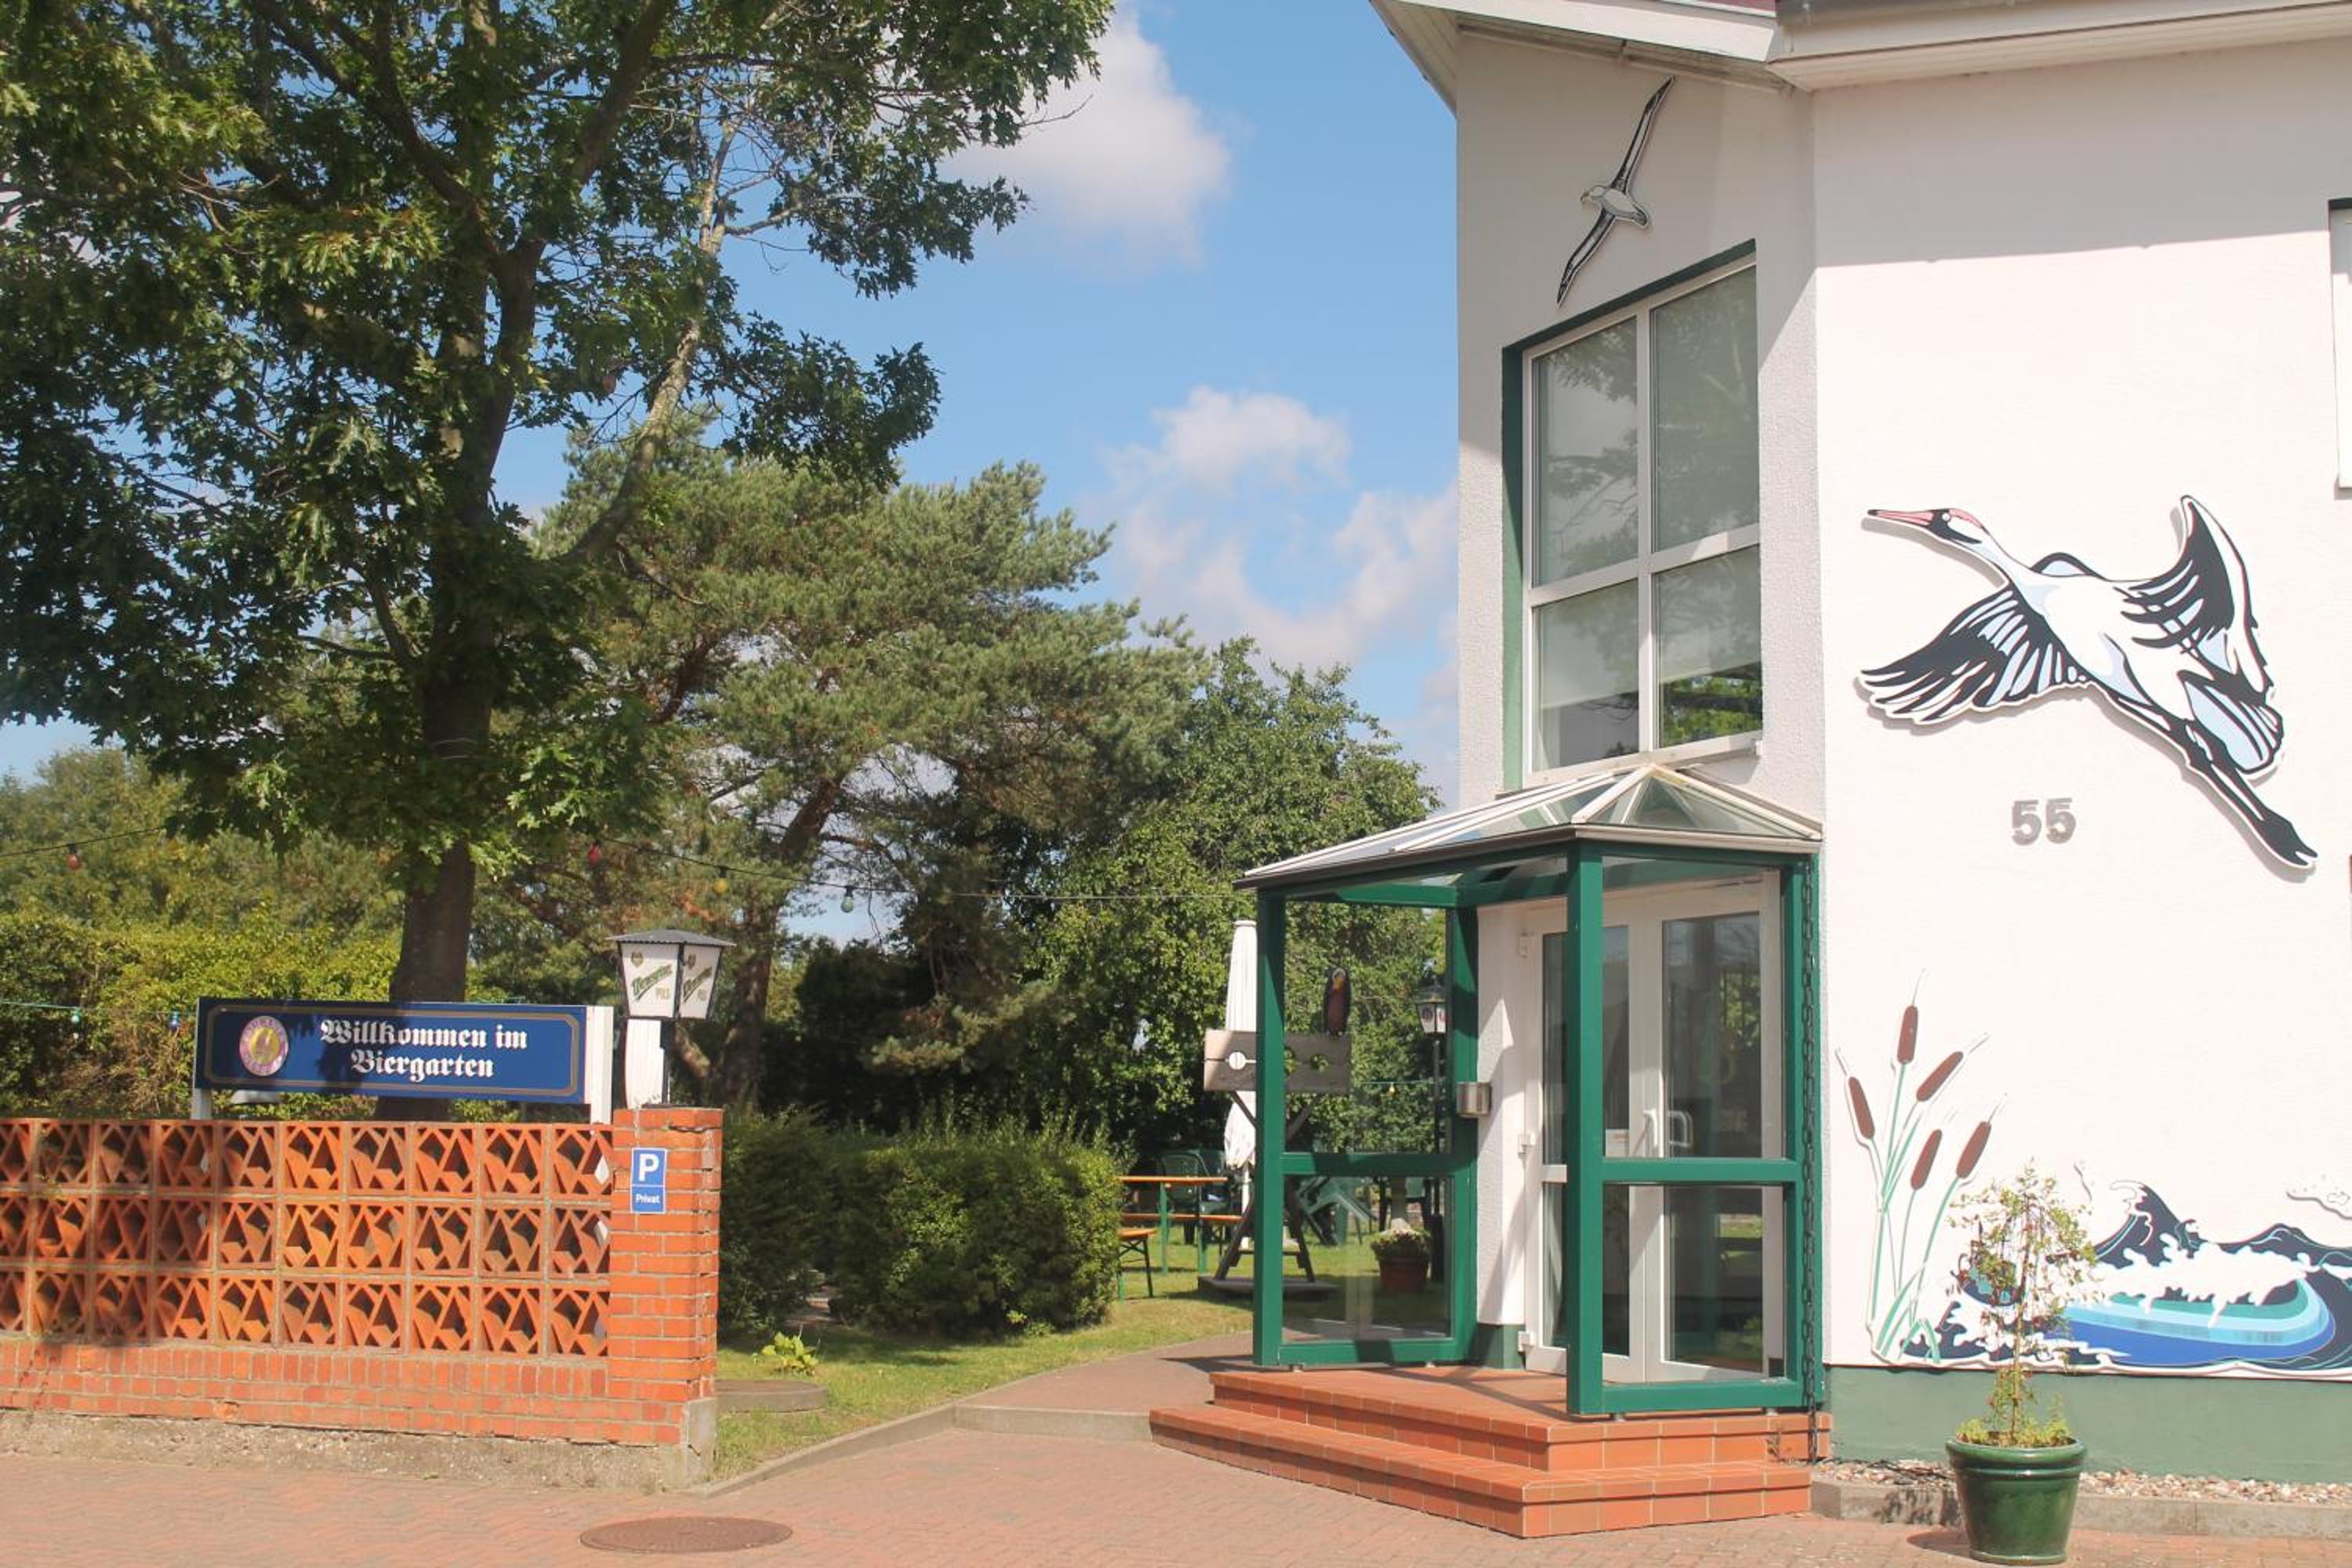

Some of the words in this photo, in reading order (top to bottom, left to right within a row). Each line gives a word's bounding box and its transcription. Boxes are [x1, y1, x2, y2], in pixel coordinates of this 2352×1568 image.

[2011, 797, 2076, 846] 55
[320, 1019, 487, 1047] Willkommen
[495, 1024, 527, 1049] im
[350, 1049, 493, 1083] Biergarten
[639, 1153, 659, 1181] P
[636, 1193, 660, 1203] Privat
